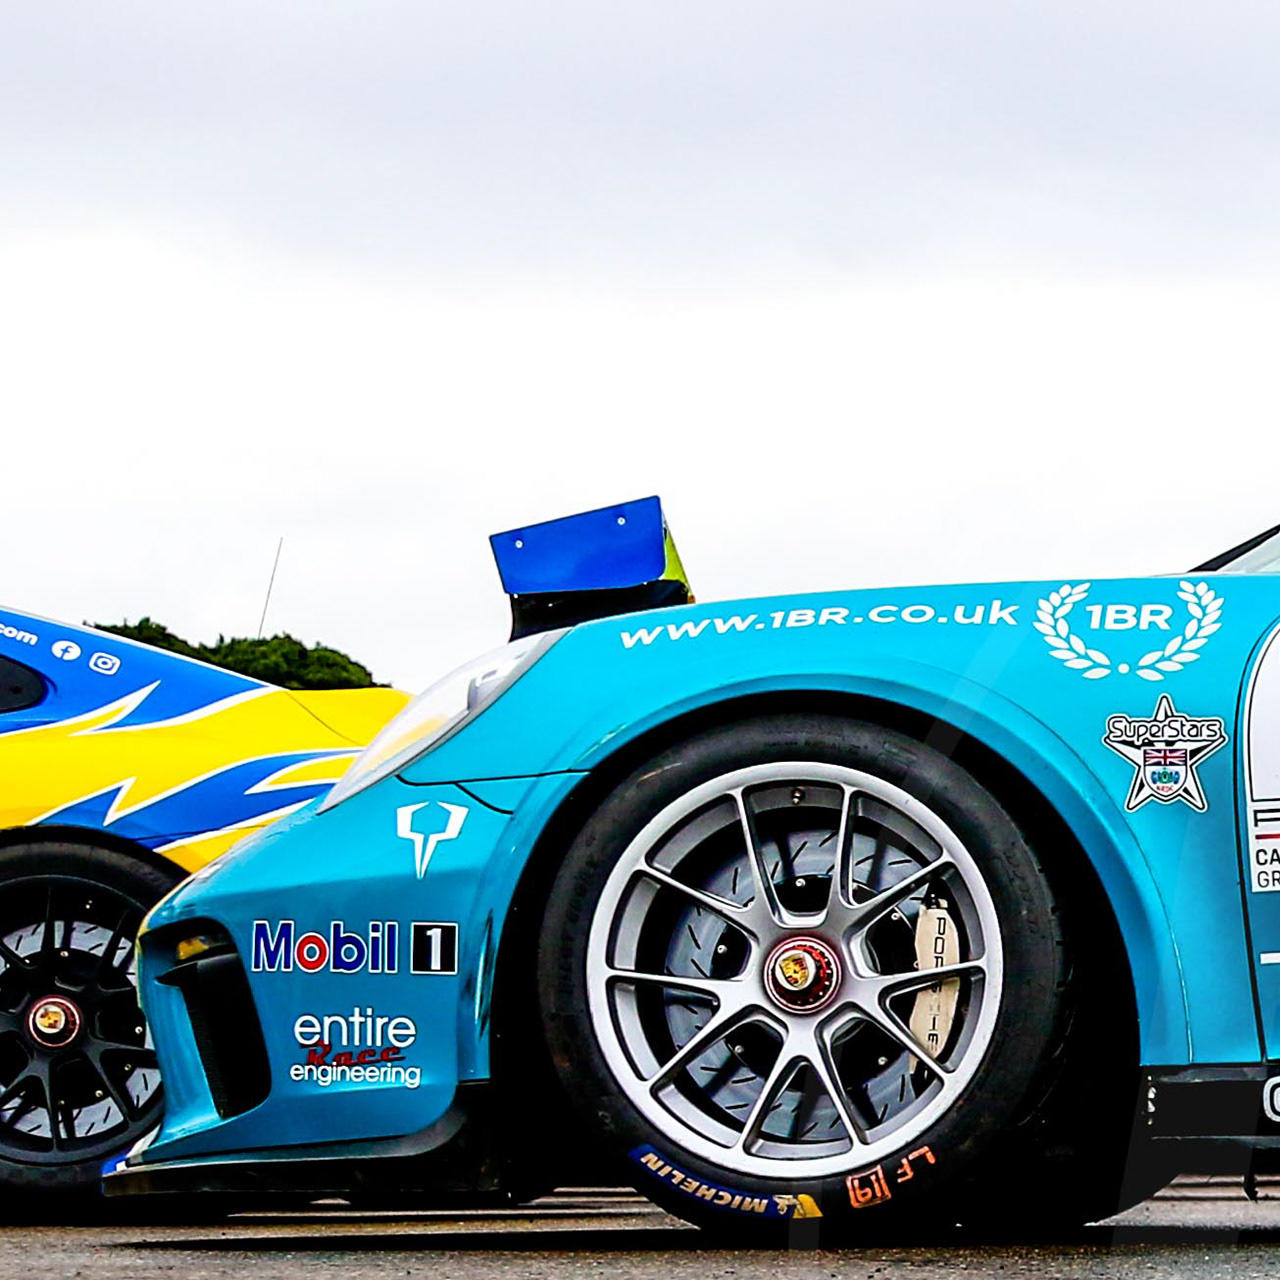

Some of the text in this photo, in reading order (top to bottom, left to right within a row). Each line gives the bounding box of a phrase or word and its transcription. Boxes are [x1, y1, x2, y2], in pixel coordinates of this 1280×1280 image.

[620, 599, 1020, 650] www.1BR.co.uk
[1087, 602, 1174, 632] 1BR
[1111, 719, 1221, 743] SuperStars
[251, 920, 399, 974] Mobil
[293, 1006, 417, 1048] entire
[289, 1060, 422, 1088] engineering
[640, 1152, 769, 1214] MICHELIN
